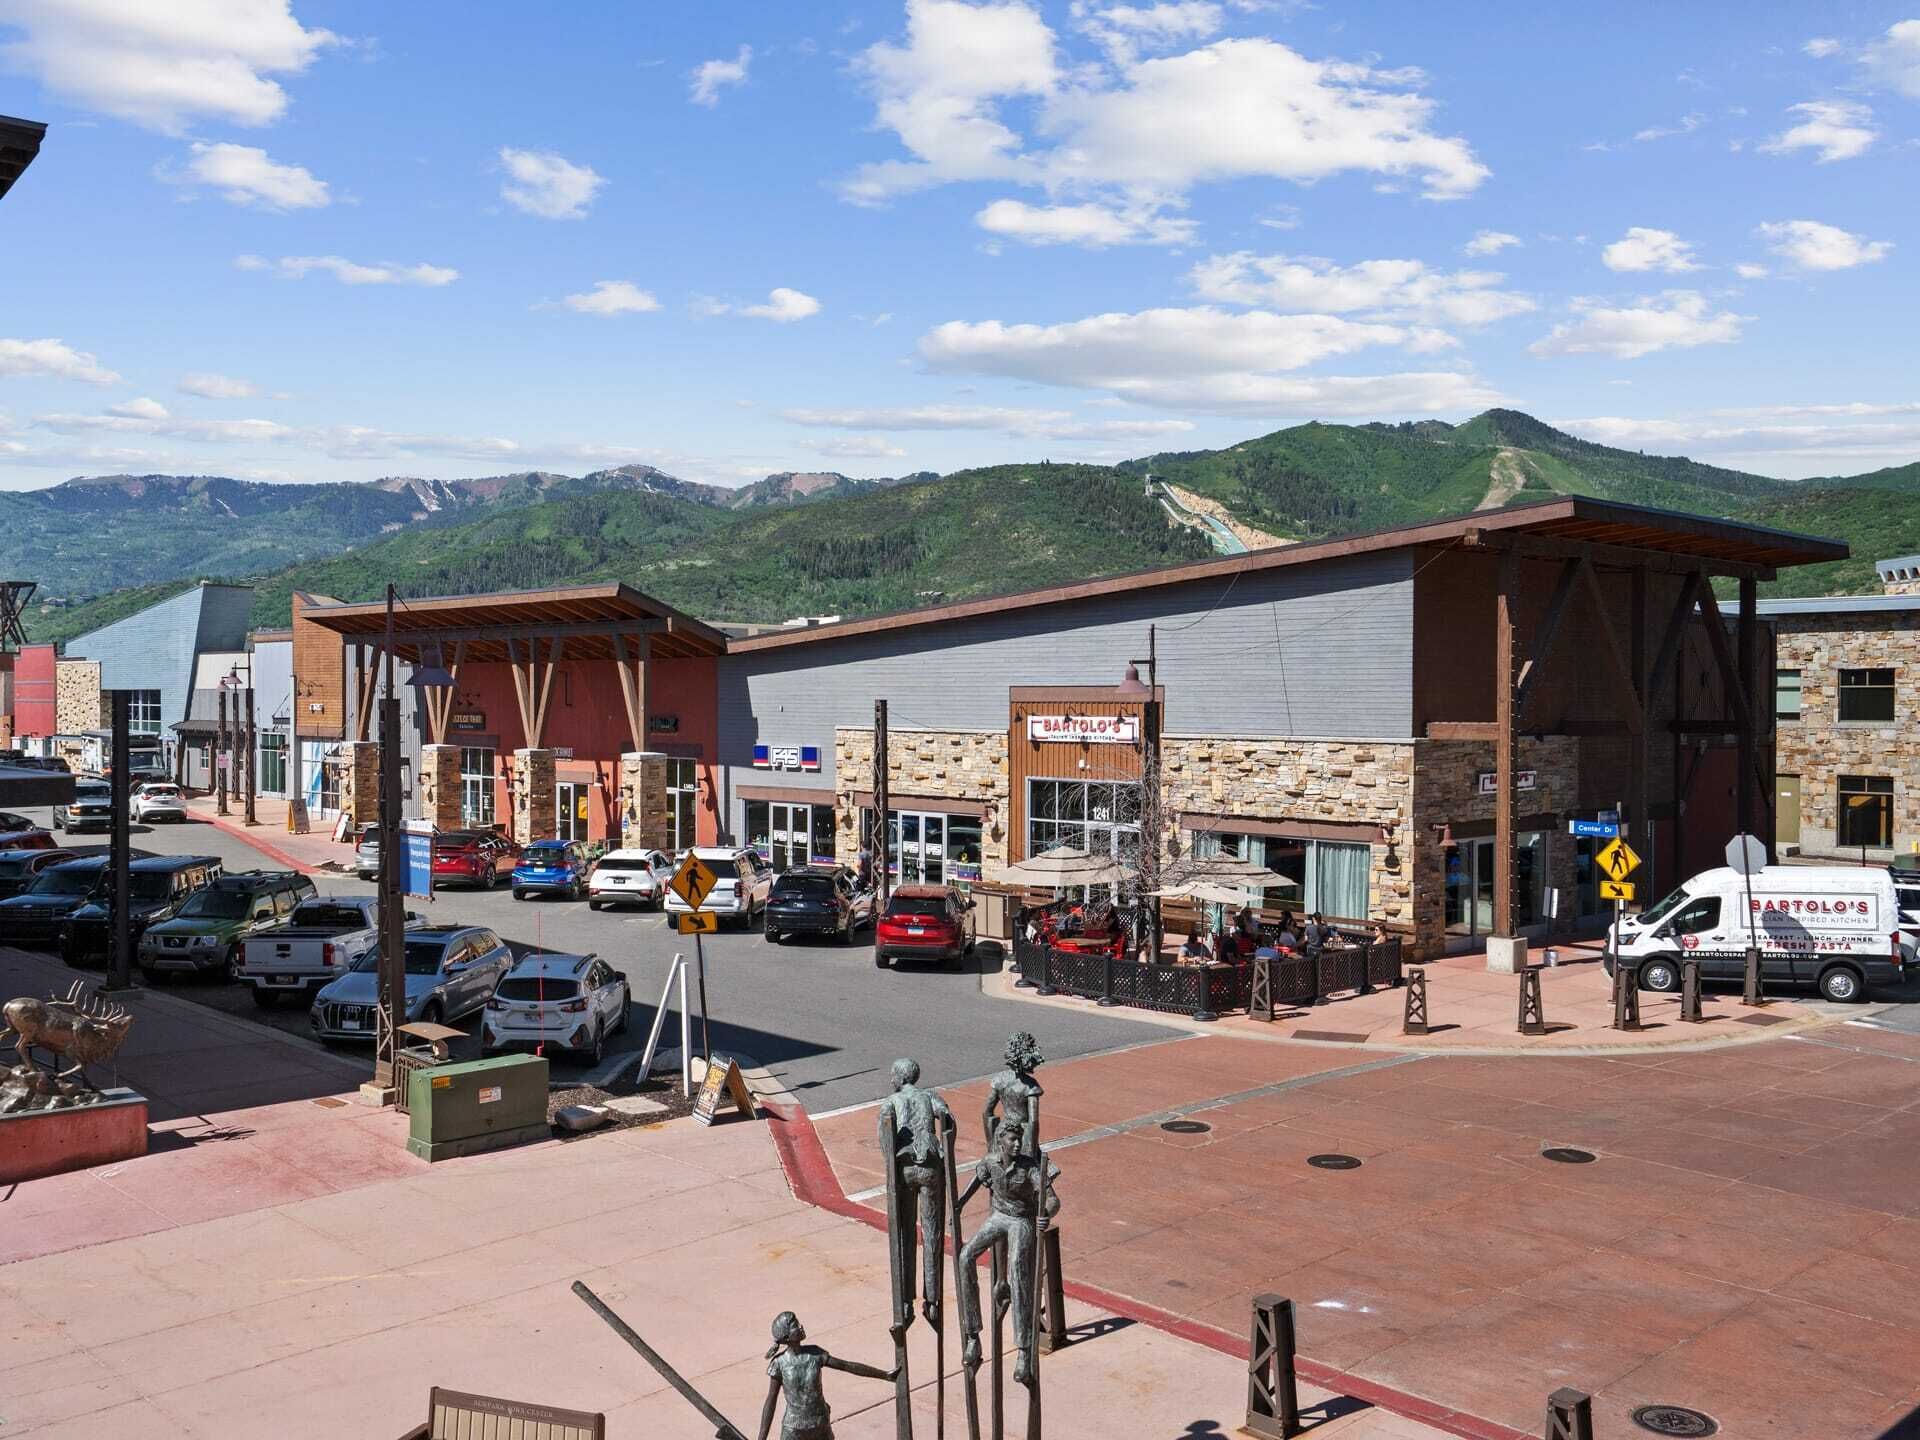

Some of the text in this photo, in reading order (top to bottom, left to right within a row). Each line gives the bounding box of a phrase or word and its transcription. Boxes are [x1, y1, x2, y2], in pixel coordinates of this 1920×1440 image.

[1043, 719, 1121, 734] BARTOLO'S
[771, 747, 799, 767] F45
[1092, 806, 1110, 820] 1241
[1578, 825, 1600, 833] Center
[1751, 899, 1869, 915] BARTOLO'S
[1830, 916, 1869, 924] KITCHEN
[1766, 941, 1852, 951] FRESH PASTA
